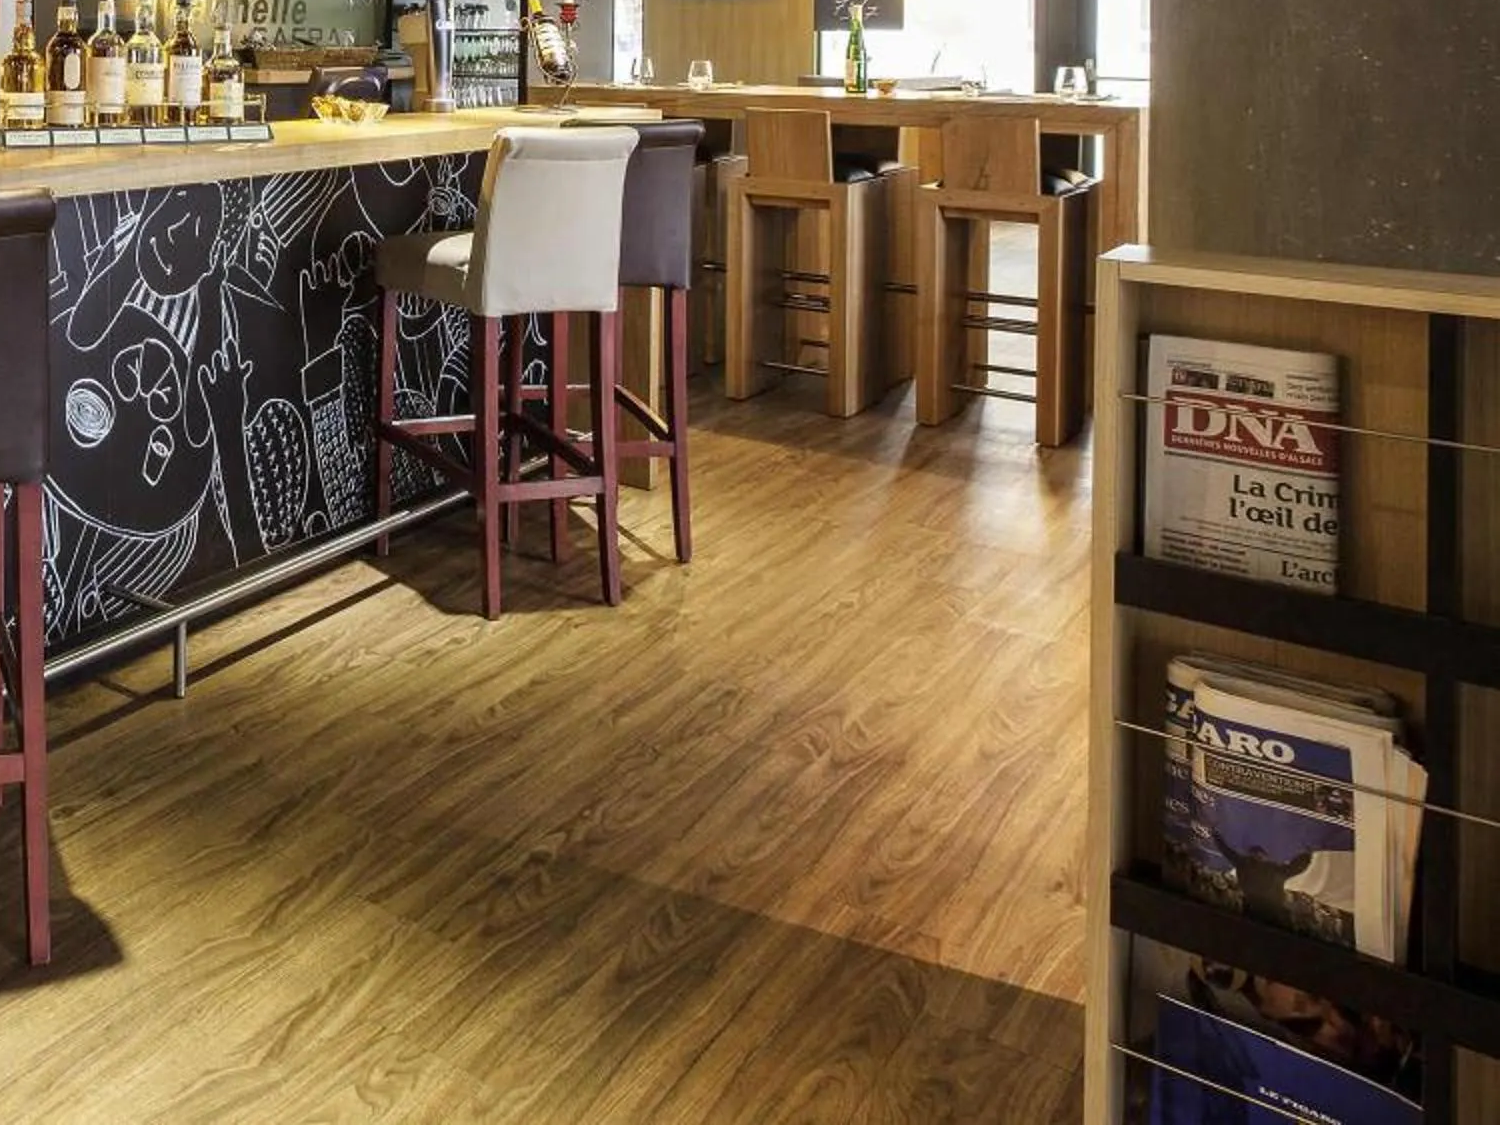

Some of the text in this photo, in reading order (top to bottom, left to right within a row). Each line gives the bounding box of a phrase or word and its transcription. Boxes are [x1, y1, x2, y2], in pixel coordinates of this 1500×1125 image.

[1171, 396, 1324, 456] DNA
[1233, 474, 1340, 509] La Crim
[1303, 512, 1338, 536] de
[1280, 560, 1339, 585] L'arc
[1196, 718, 1296, 765] ARO
